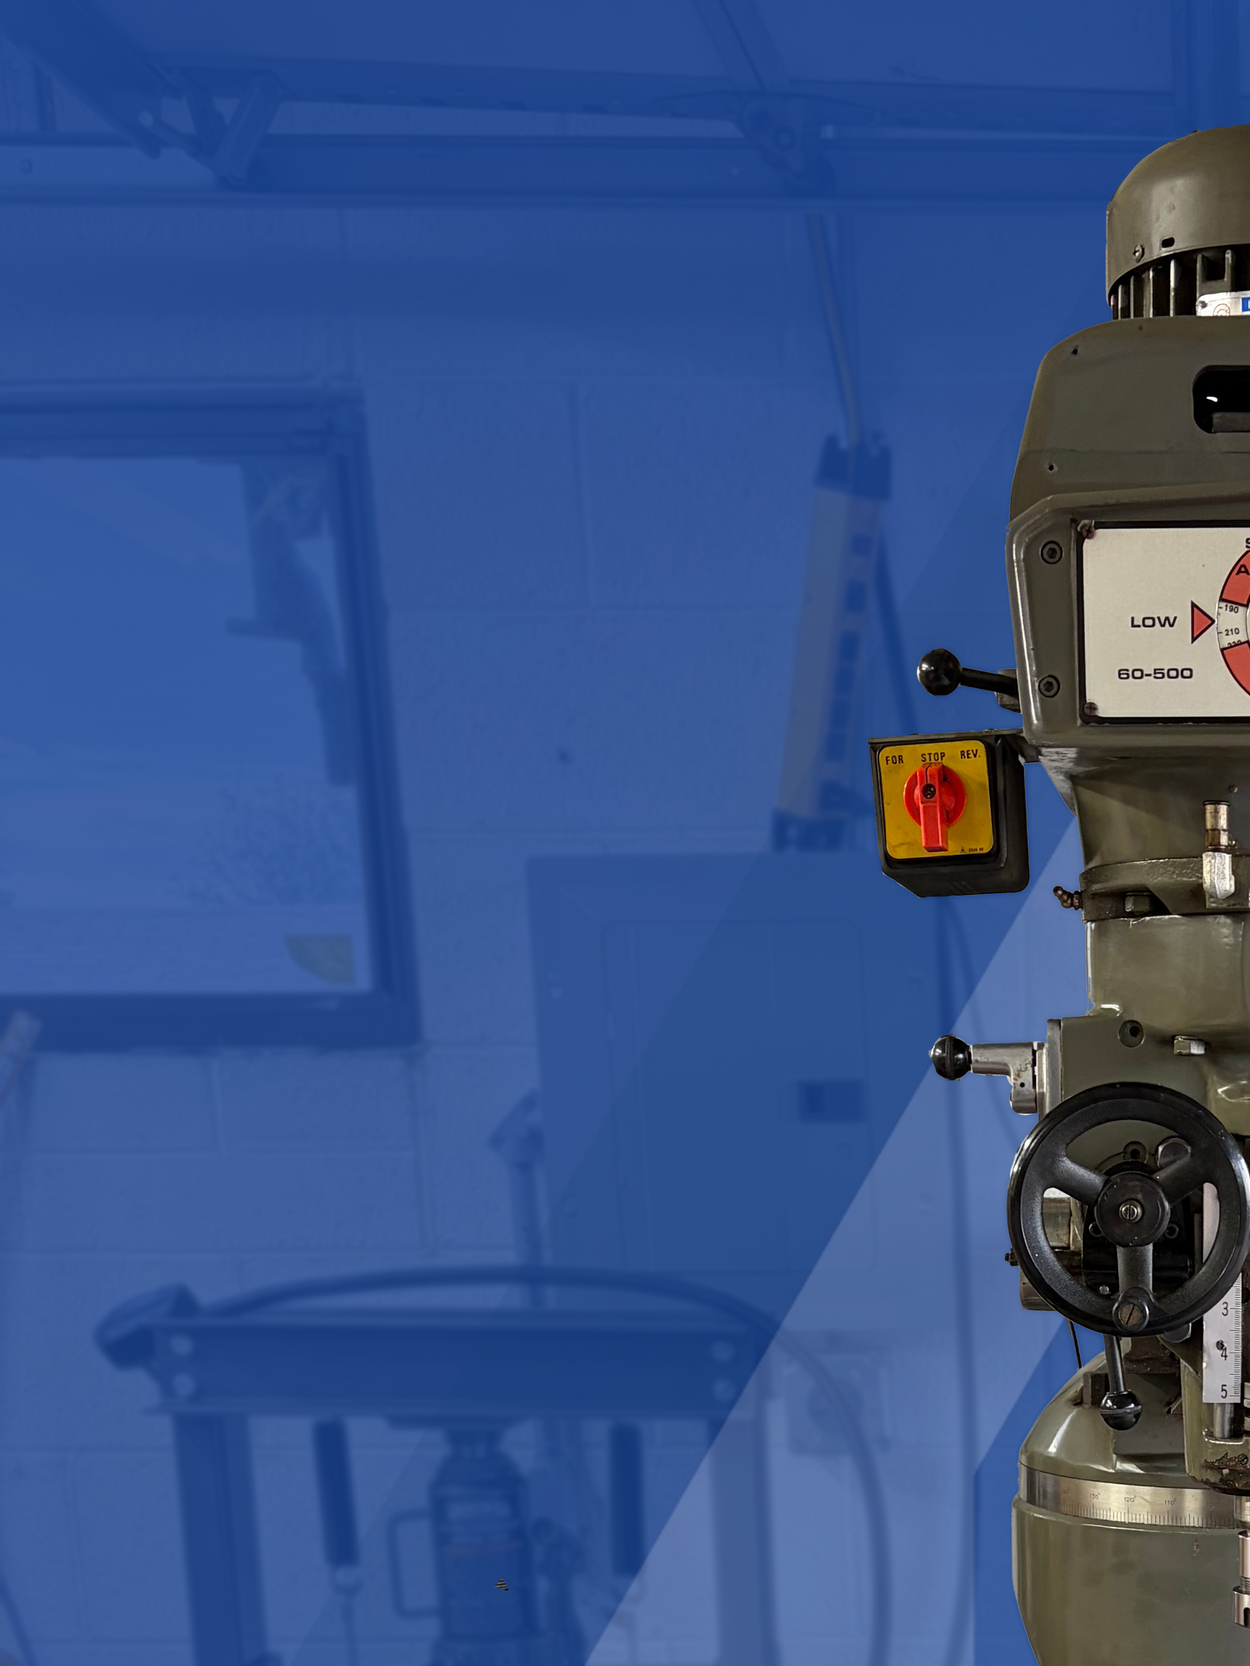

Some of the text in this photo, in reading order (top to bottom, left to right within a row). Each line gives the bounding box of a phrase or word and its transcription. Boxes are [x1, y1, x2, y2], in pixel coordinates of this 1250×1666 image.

[1224, 604, 1239, 614] 190
[1131, 616, 1177, 628] LOW
[1224, 627, 1240, 636] 210
[1118, 668, 1193, 680] 60-500
[885, 749, 981, 765] FOR STOP REV.
[1221, 1302, 1229, 1316] 3
[1220, 1348, 1228, 1361] 4
[1220, 1384, 1228, 1399] 5
